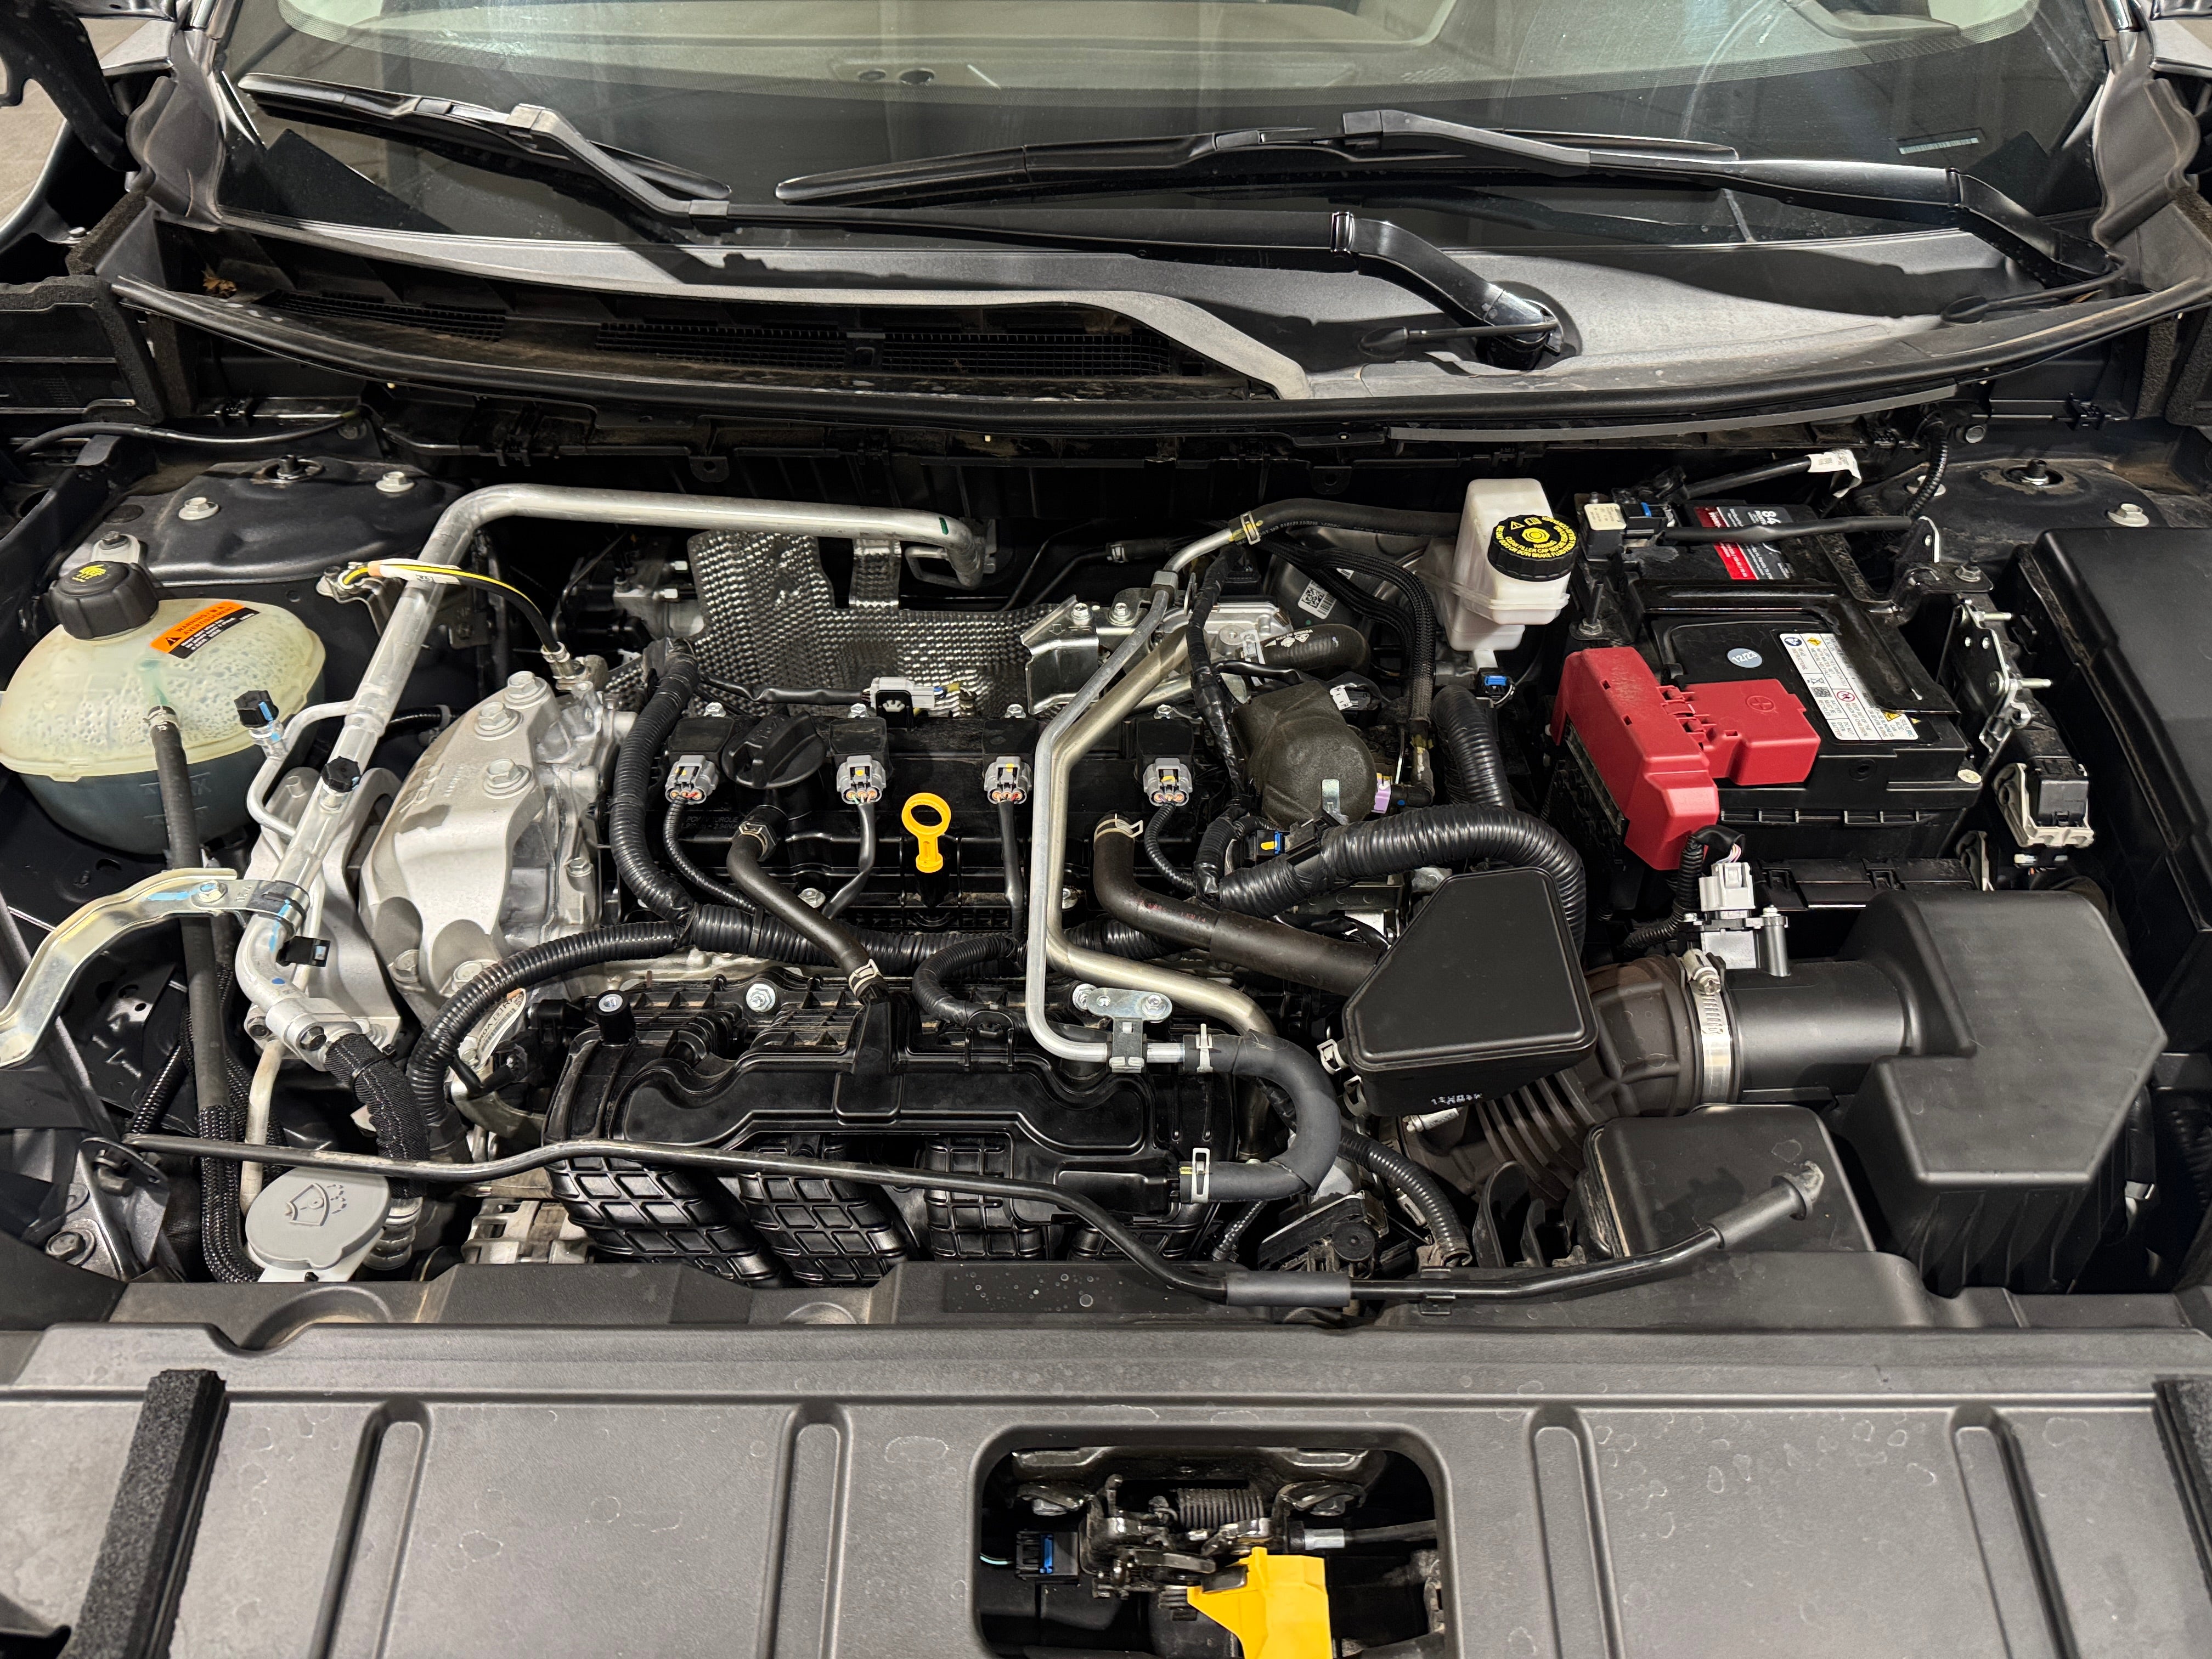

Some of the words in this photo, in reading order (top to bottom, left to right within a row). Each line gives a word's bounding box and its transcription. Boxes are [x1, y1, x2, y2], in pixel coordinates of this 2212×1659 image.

[1754, 510, 1767, 524] MONTH
[1760, 511, 1782, 524] 84
[1505, 537, 1520, 547] CLEAN
[1517, 545, 1537, 553] FILLER
[1548, 541, 1567, 552] BEFORE
[176, 614, 207, 633] WARNING
[184, 606, 235, 635] AVERTISSEMENT
[1732, 651, 1758, 663] 12/23
[1791, 648, 1808, 669] INSTRUCTIONS
[1797, 648, 1807, 656] READ
[1817, 700, 1831, 716] RECYCLED
[1823, 700, 1833, 708] MUST
[1830, 700, 1843, 713] BATTERY
[1850, 703, 1860, 711] KEEP
[1844, 703, 1855, 713] REACH
[1853, 719, 1869, 736] CHILDREN
[1873, 709, 1884, 719] CAUSE
[1830, 722, 1843, 736] BATTERY
[1836, 722, 1847, 731] OPEN
[1894, 721, 1904, 730] ACID
[1898, 719, 1916, 737] SULFURIC
